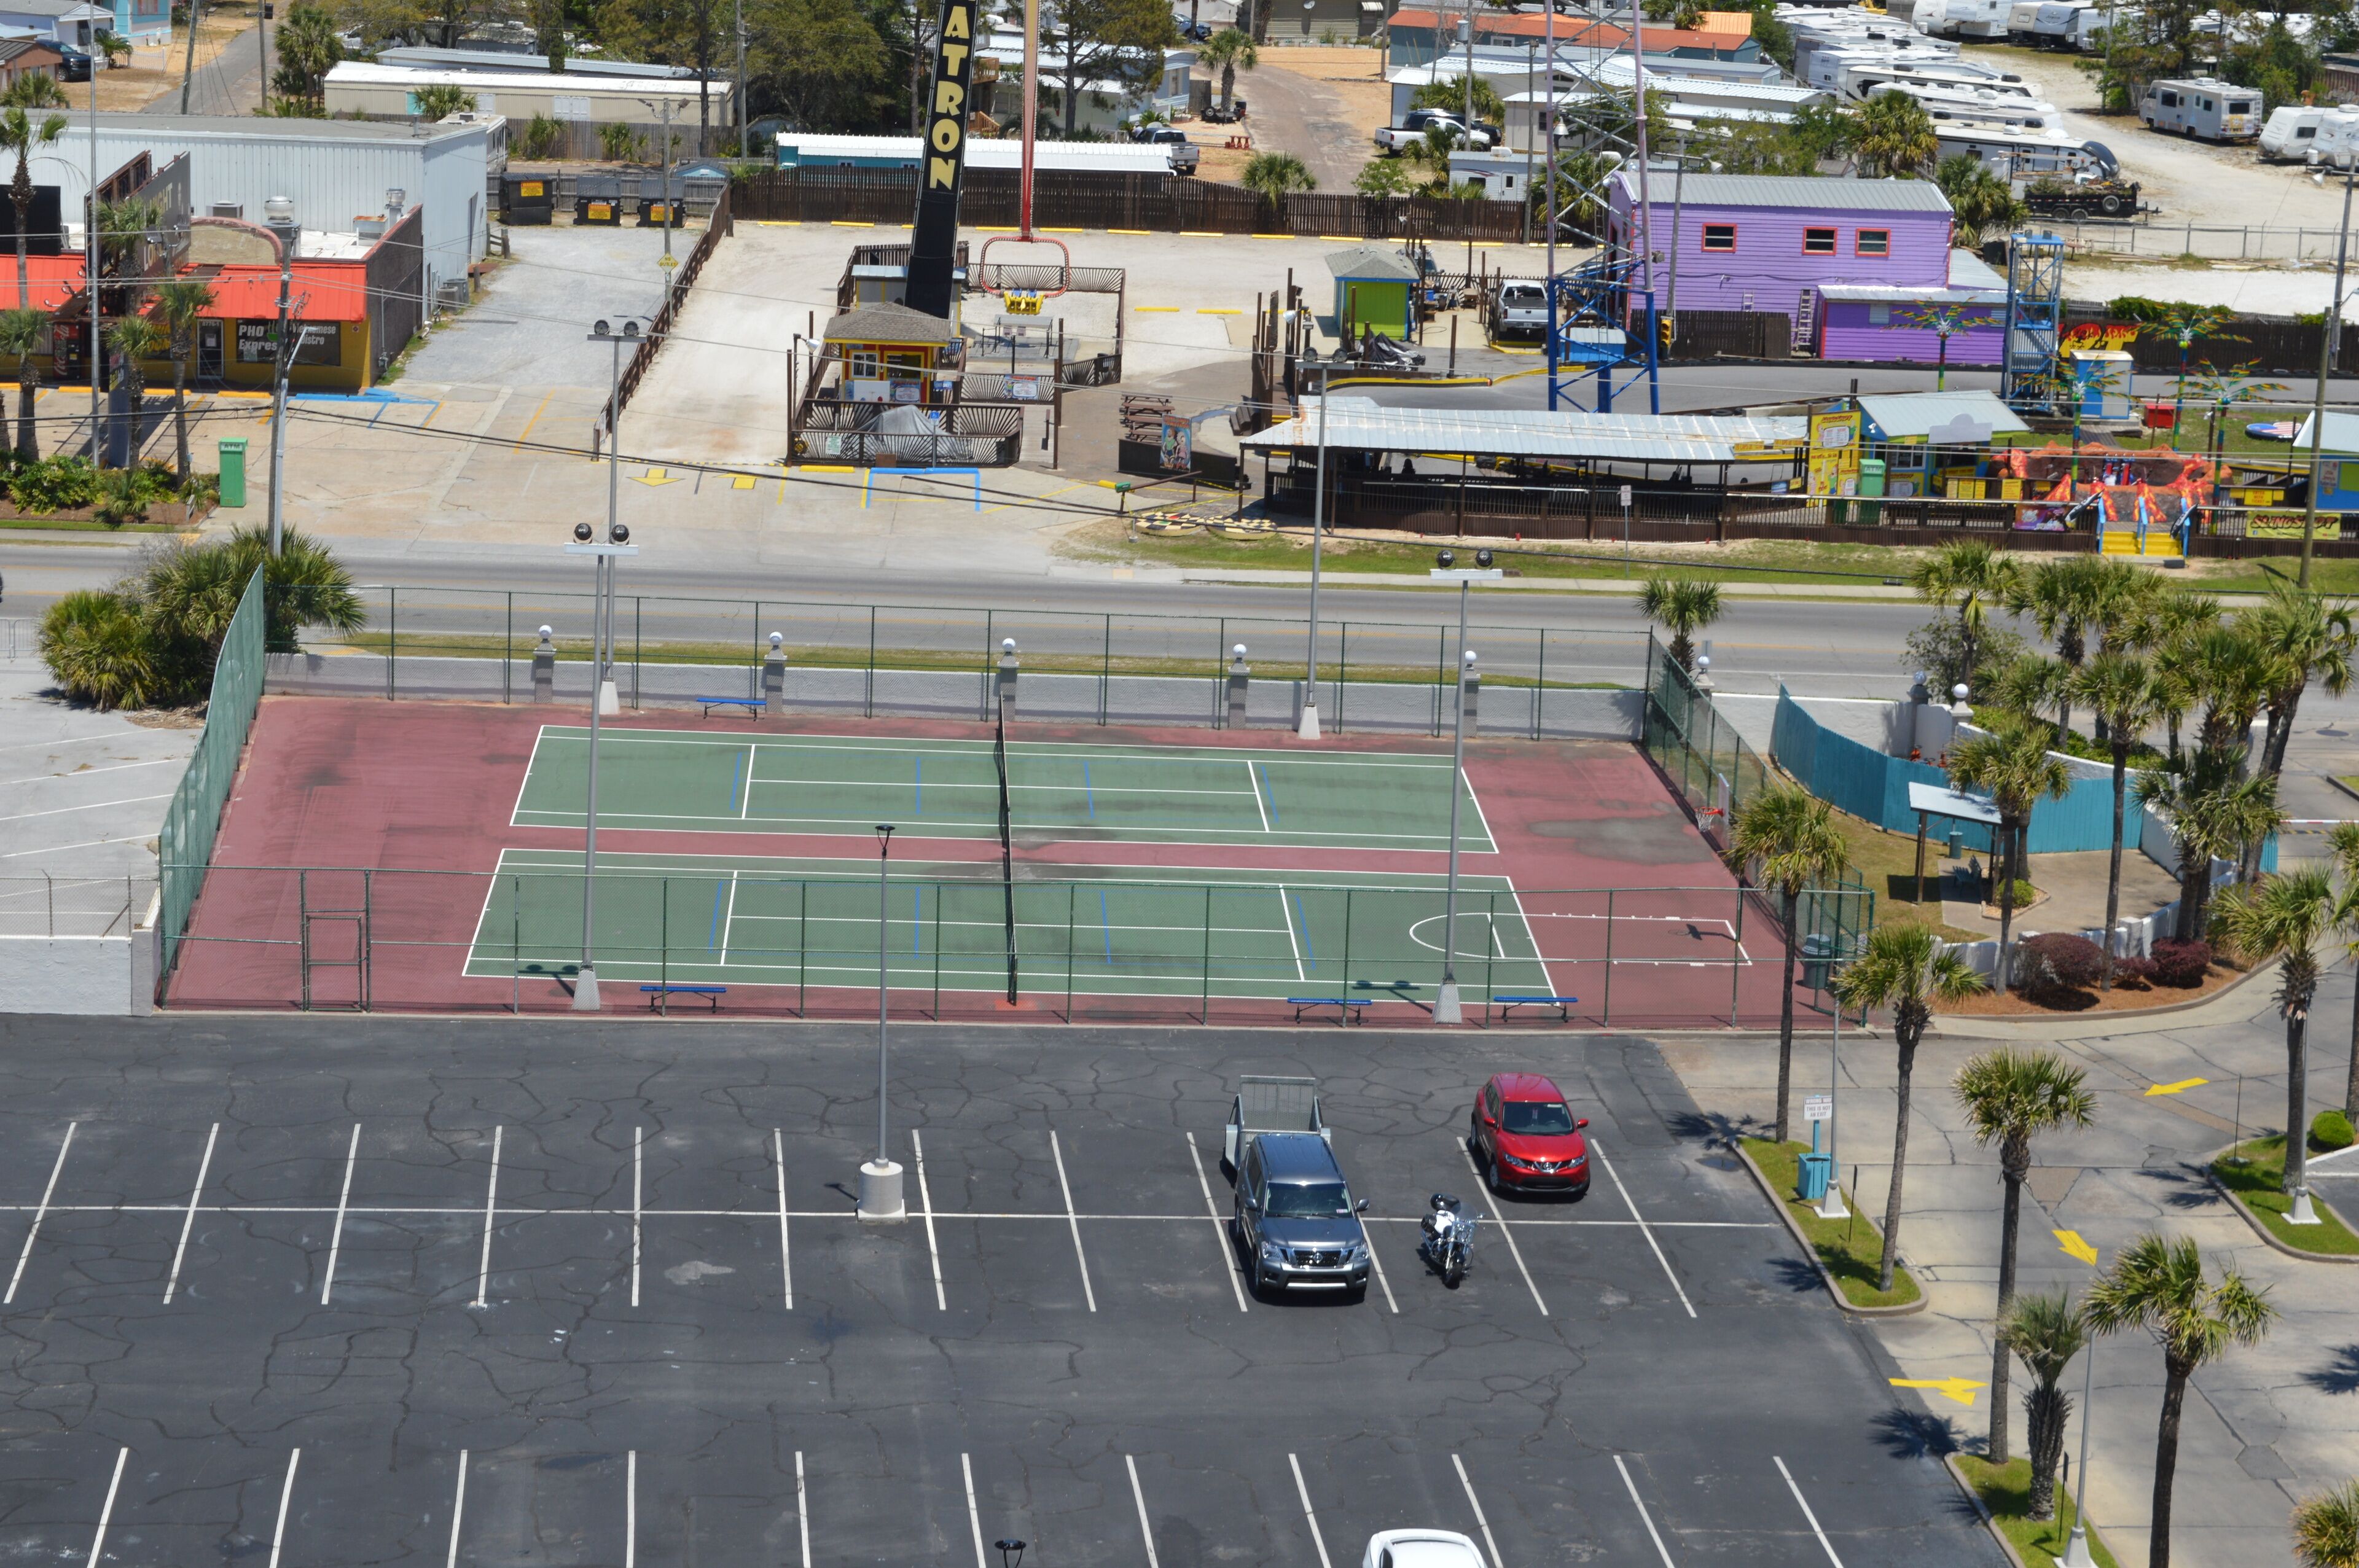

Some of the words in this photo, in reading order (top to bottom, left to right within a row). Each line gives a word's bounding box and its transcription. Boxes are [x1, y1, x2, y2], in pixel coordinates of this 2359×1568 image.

[929, 5, 970, 190] ATRON
[238, 325, 264, 337] PHO
[238, 338, 278, 354] Expres
